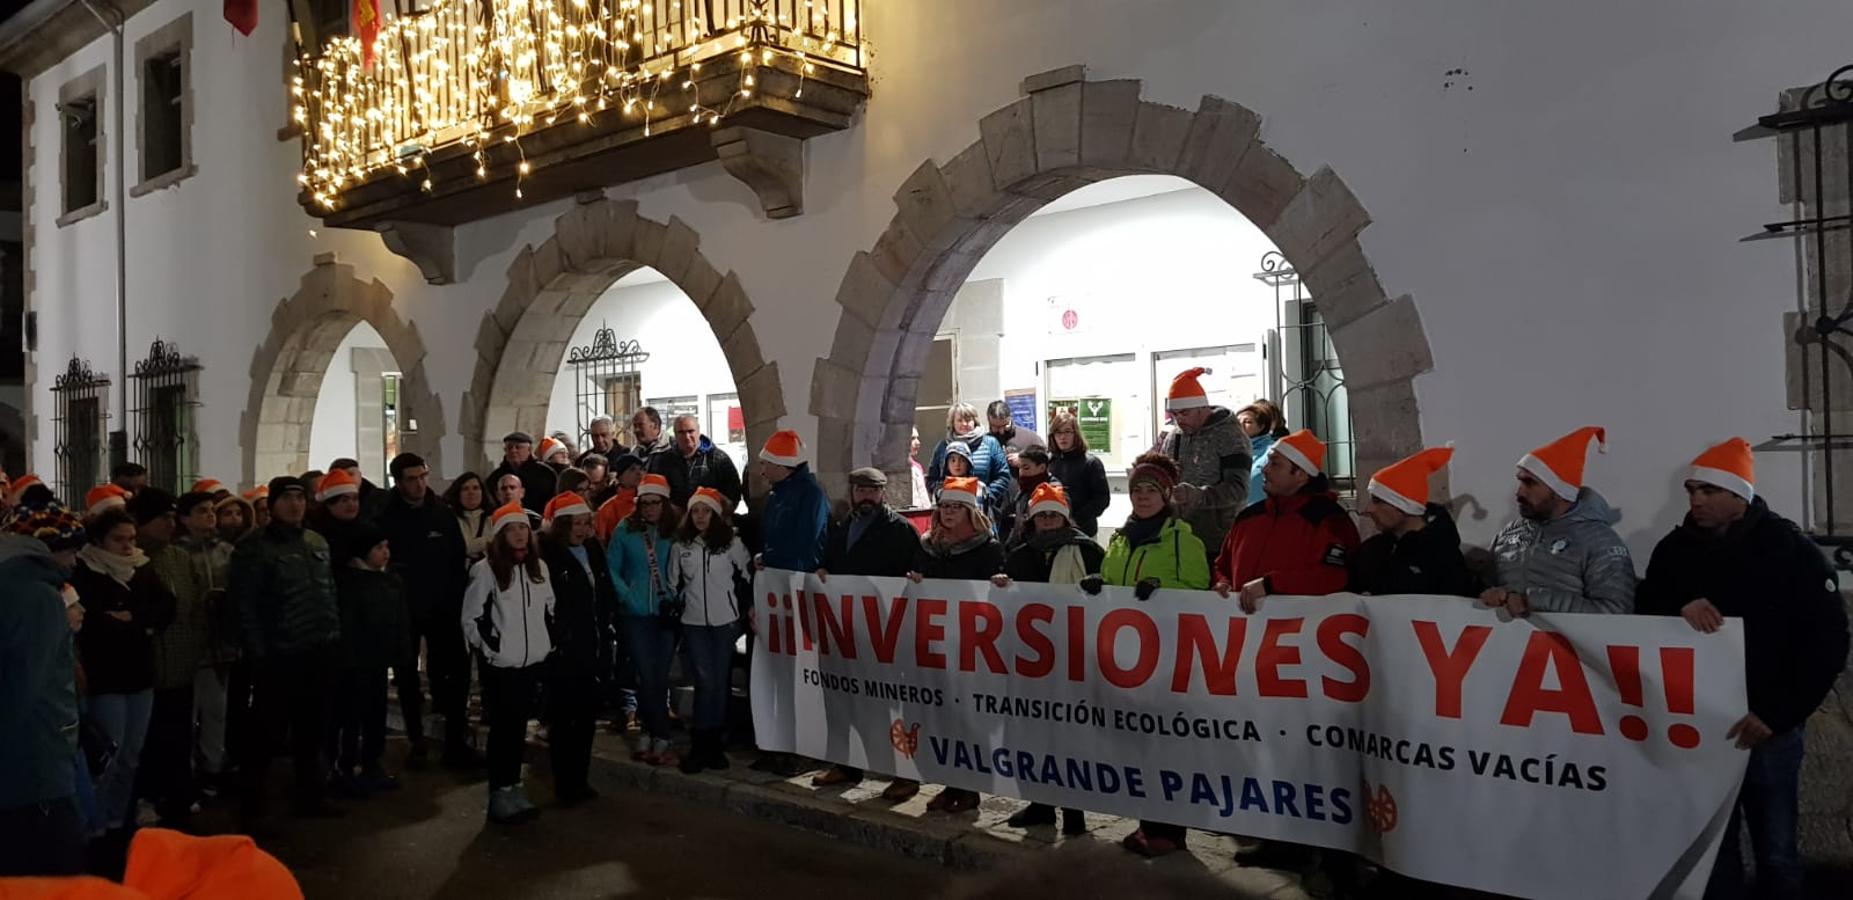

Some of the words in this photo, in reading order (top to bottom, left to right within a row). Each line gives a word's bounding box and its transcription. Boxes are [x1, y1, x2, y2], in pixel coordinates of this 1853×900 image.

[767, 590, 1371, 702] ¡¡INVERSIONES
[1411, 620, 1702, 750] YA!!
[804, 668, 860, 694] FONDOS
[865, 679, 944, 707] MINEROS
[973, 693, 1106, 728] TRANSICIÓN
[1115, 709, 1262, 742] ECOLÓGICA
[929, 736, 1147, 798] VALGRANDE
[1159, 769, 1353, 825] PAJARES
[1306, 724, 1455, 771] COMARCAS
[1468, 749, 1607, 792] VACÍAS
